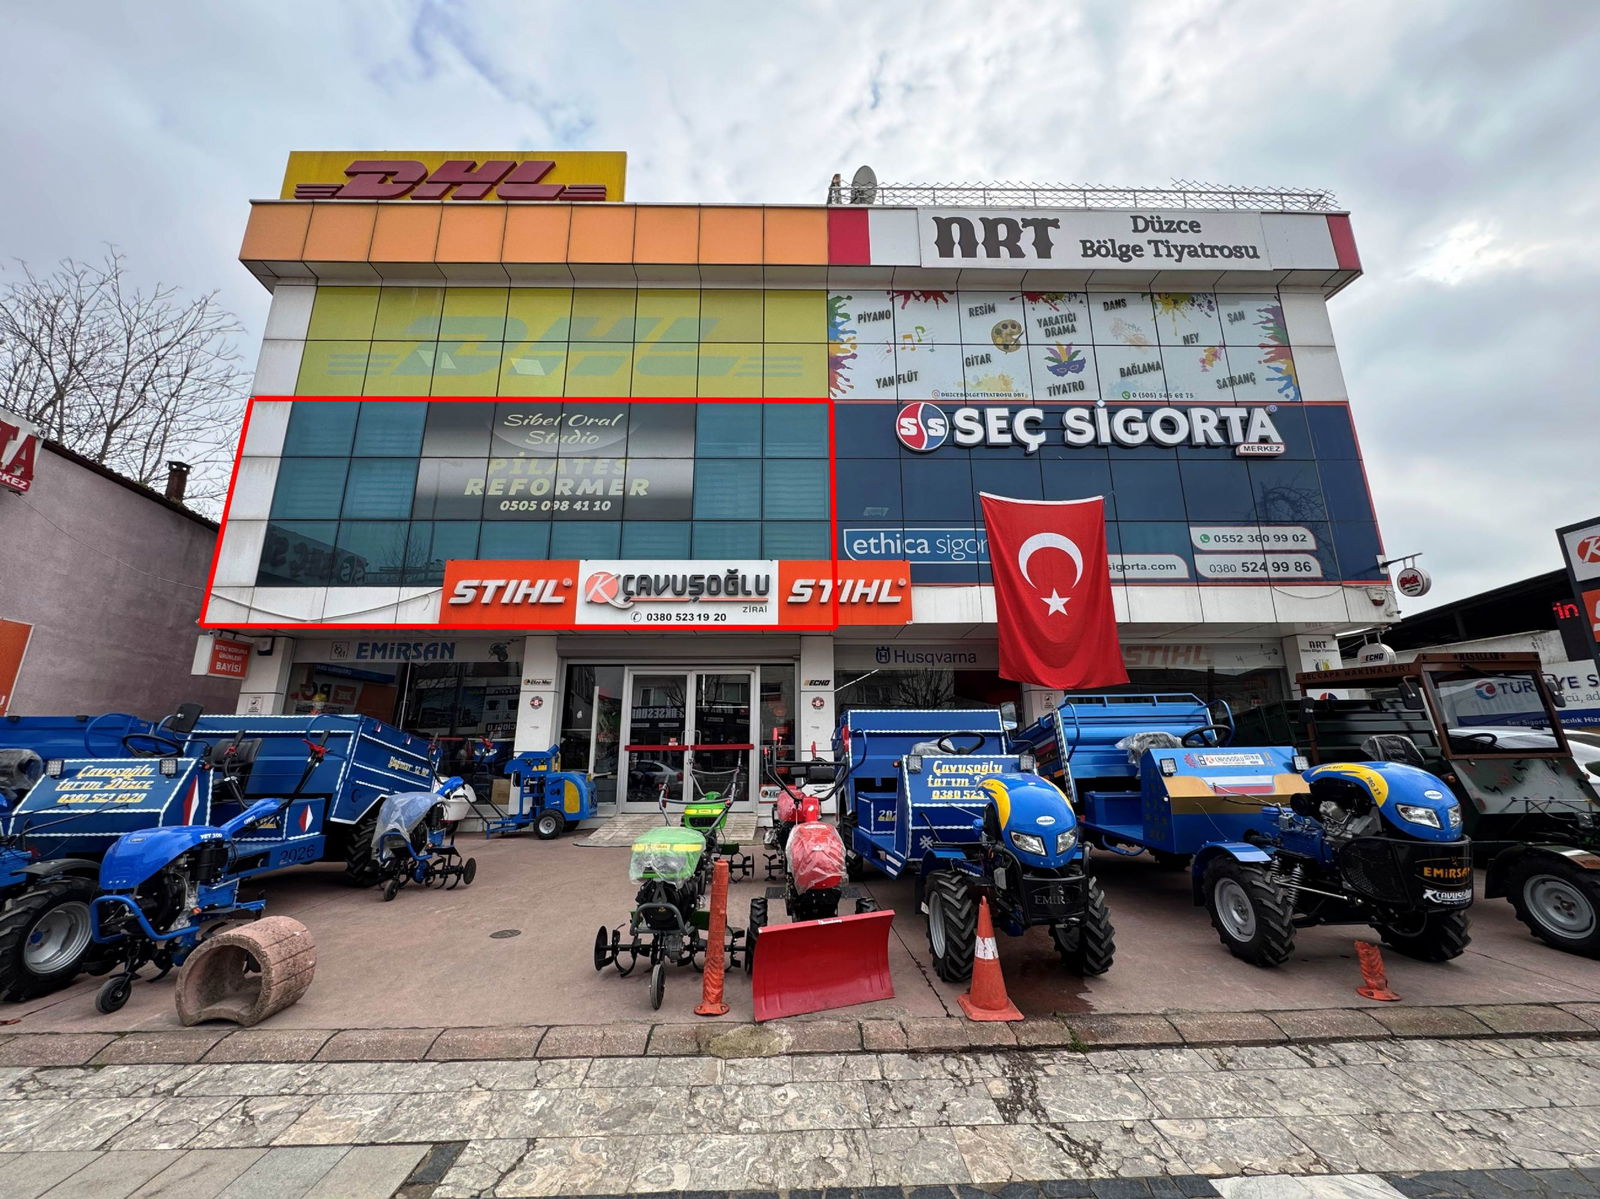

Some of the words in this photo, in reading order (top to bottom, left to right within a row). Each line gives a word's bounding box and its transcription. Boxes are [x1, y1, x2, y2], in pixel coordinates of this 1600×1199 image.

[335, 160, 567, 200] DHL
[1131, 215, 1203, 235] Düzce
[1080, 238, 1146, 262] Bölge
[1152, 238, 1261, 264] Tiyatrosu
[968, 303, 996, 318] RESİM
[1102, 298, 1127, 312] DANS
[857, 309, 892, 324] PİYANO
[1036, 312, 1077, 329] YARATICI
[1226, 310, 1246, 326] ŞAN
[1044, 324, 1077, 339] DRAMA
[1182, 332, 1200, 346] NEY
[391, 316, 737, 377] DHL
[965, 353, 992, 368] GİTAR
[1119, 360, 1162, 379] BAĞLAMA
[875, 375, 895, 390] YAN
[896, 370, 919, 385] FLÜT
[1046, 380, 1085, 397] TİYATRO
[1216, 372, 1257, 391] SATRANÇ
[504, 412, 562, 427] Sibel
[567, 412, 624, 427] Oral
[952, 406, 1047, 455] SEÇ
[1063, 399, 1284, 448] SİGORTA
[524, 429, 601, 446] Studio
[1243, 444, 1281, 453] MERKEZ
[488, 452, 632, 476] PİLATES
[0, 471, 28, 490] KEZ
[464, 477, 650, 497] REFORMER
[500, 500, 538, 511] 0505
[540, 500, 573, 511] 098
[573, 500, 590, 511] 41
[592, 500, 612, 511] 10
[852, 530, 931, 556] ethica
[1213, 534, 1244, 543] 0552
[1247, 534, 1270, 543] 360
[1273, 534, 1289, 543] 99
[1292, 534, 1308, 543] 02
[1209, 563, 1237, 573] 0380
[1241, 561, 1267, 573] 524
[1271, 561, 1290, 573] 99
[1294, 561, 1312, 573] 86
[447, 578, 566, 606] STIHL
[622, 568, 771, 604] ÇAVUŞOĞLU
[786, 578, 903, 604] STIHL
[646, 612, 673, 623] 0380
[675, 612, 696, 623] 523
[696, 612, 711, 623] 19
[713, 612, 727, 623] 20
[894, 647, 977, 666] Husqvarna
[1123, 645, 1212, 665] STIHL
[1365, 653, 1384, 662] ECHO
[215, 661, 242, 673] BAYİSİ
[77, 764, 155, 781] Çavuşoğlu
[932, 760, 1003, 776] Çavuşoğlu
[104, 778, 154, 790] Düzce
[927, 774, 970, 787] tarım
[58, 793, 89, 803] 0380
[89, 793, 114, 803] 523
[931, 790, 961, 799] 0380
[963, 790, 985, 799] 523
[279, 844, 316, 866] 2026
